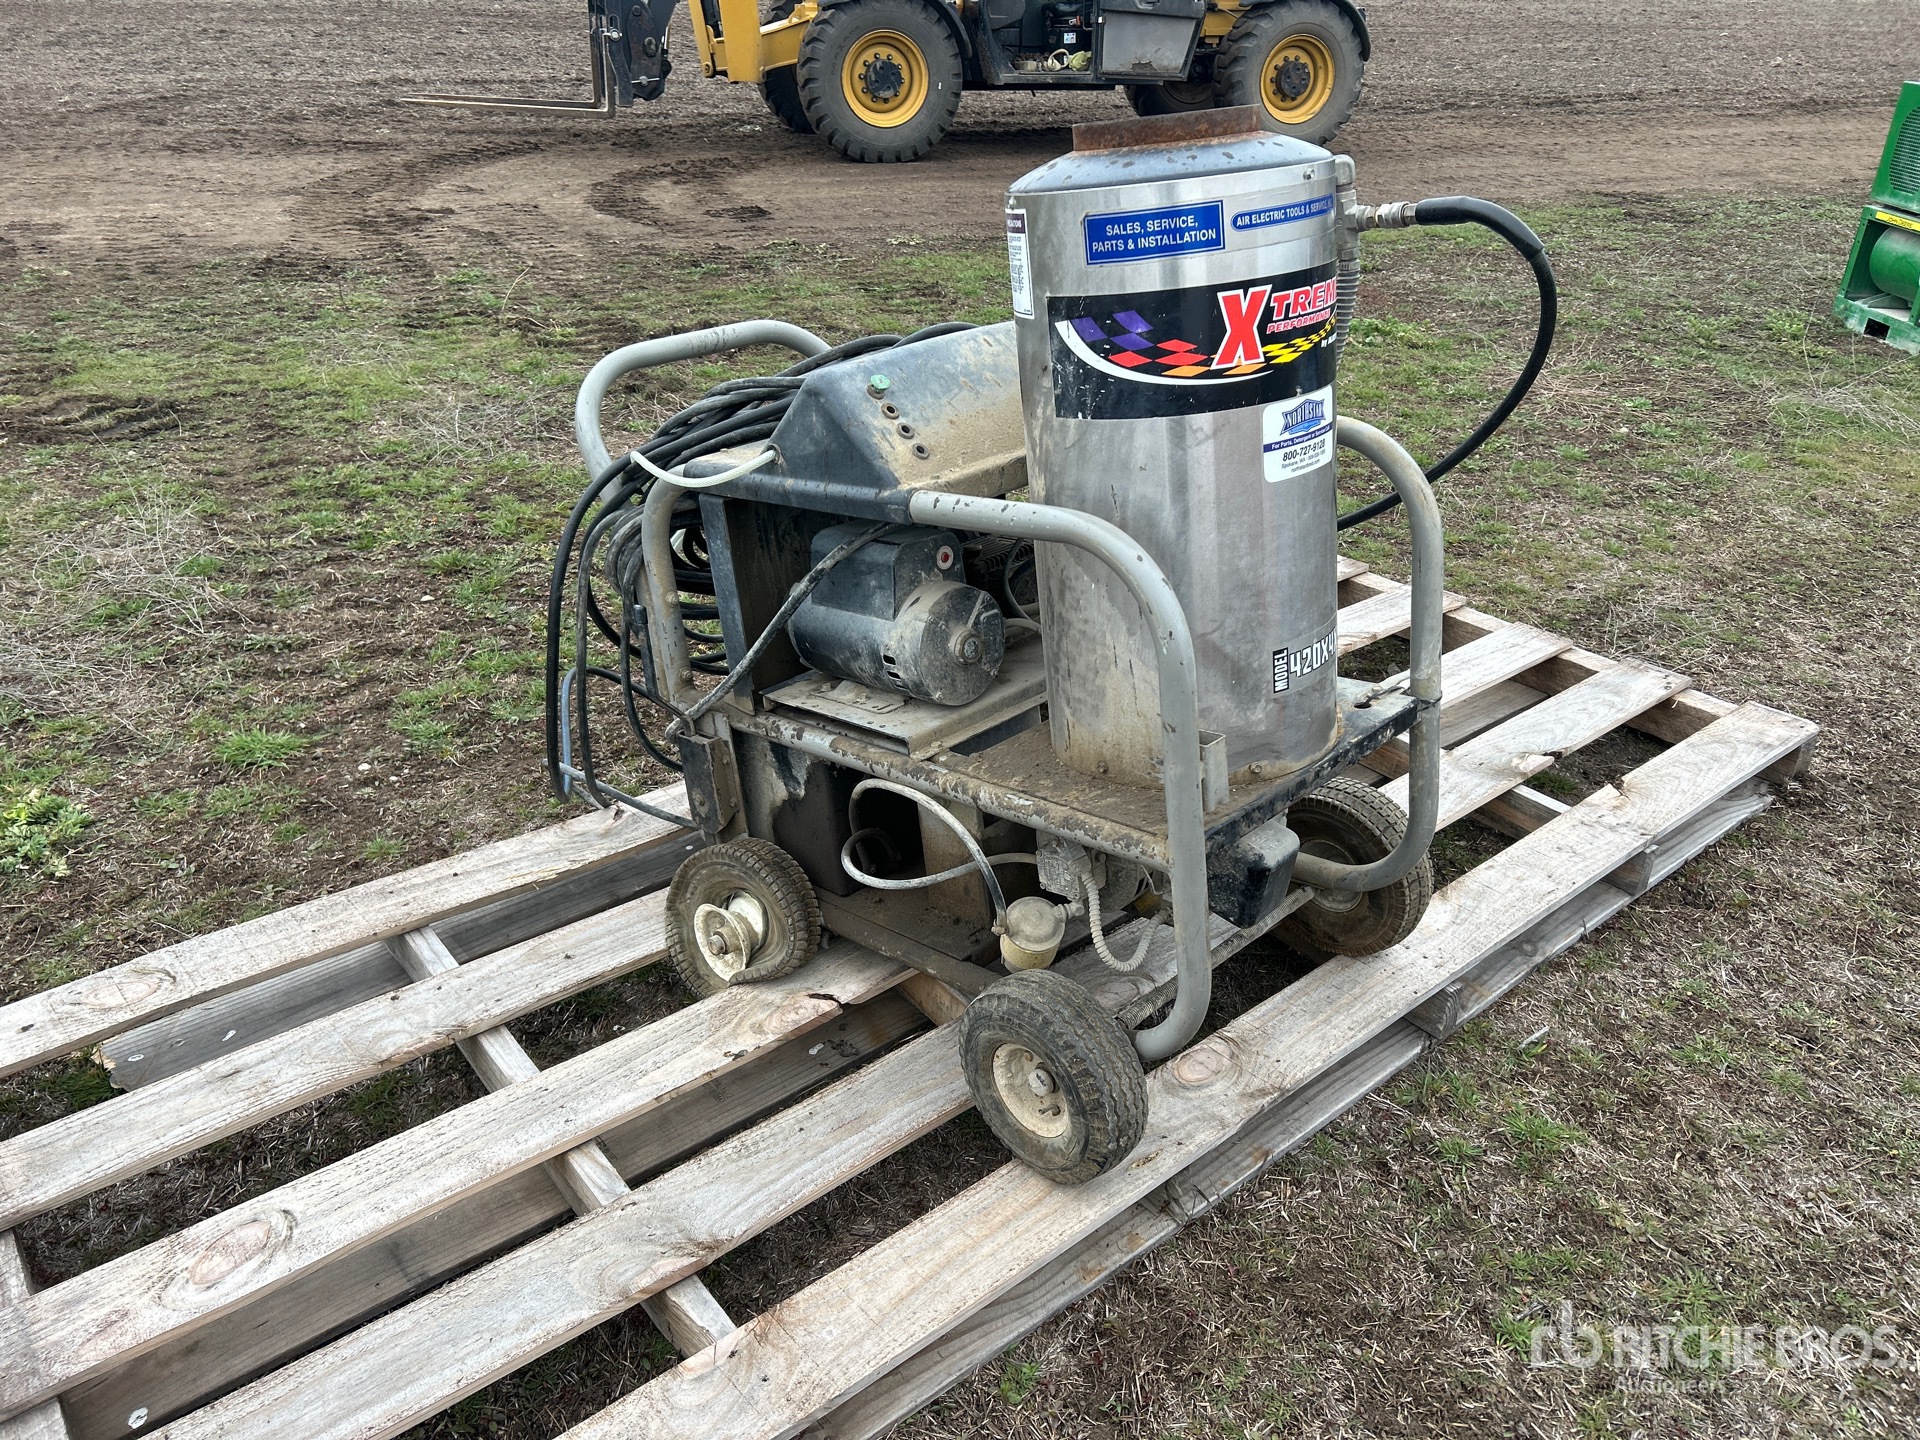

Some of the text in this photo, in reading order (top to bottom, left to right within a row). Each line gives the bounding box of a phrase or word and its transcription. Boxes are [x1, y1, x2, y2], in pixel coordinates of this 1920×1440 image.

[1106, 215, 1198, 236] SALES, SERVICE,
[1236, 215, 1251, 227] AIR
[1251, 209, 1286, 225] ELECTRIC
[1286, 205, 1305, 218] TOOLS
[1305, 205, 1310, 214] &
[1092, 228, 1217, 253] PARTS & INSTALLATION
[1211, 276, 1337, 370] XTREM
[1273, 648, 1289, 693] MODEL
